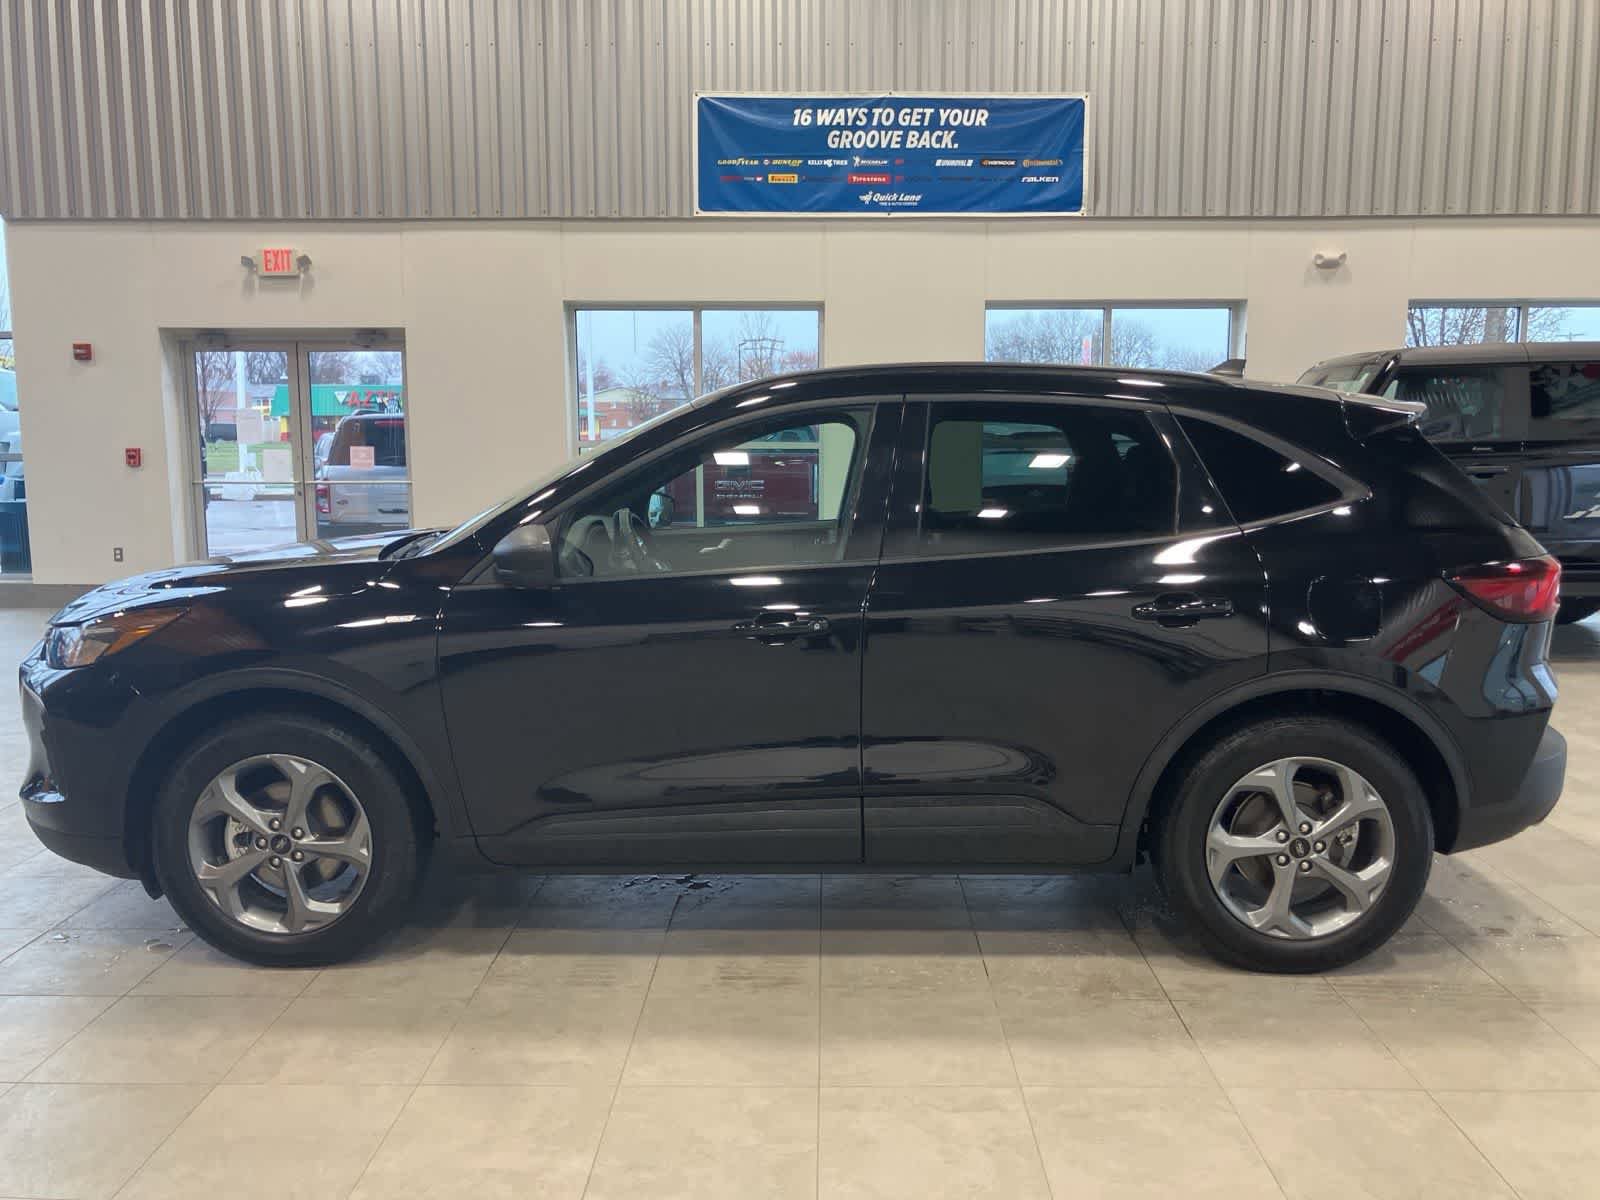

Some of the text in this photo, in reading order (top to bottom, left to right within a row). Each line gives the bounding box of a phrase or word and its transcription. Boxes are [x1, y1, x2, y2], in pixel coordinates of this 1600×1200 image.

[793, 108, 989, 126] 16 WAYS TO GET YOUR
[827, 130, 959, 149] GROOVE BACK.
[717, 158, 759, 167] GOODYEAR
[851, 175, 887, 183] Firestone
[872, 192, 923, 202] Quick Lane
[263, 248, 292, 272] EXIT
[714, 479, 765, 490] GMC
